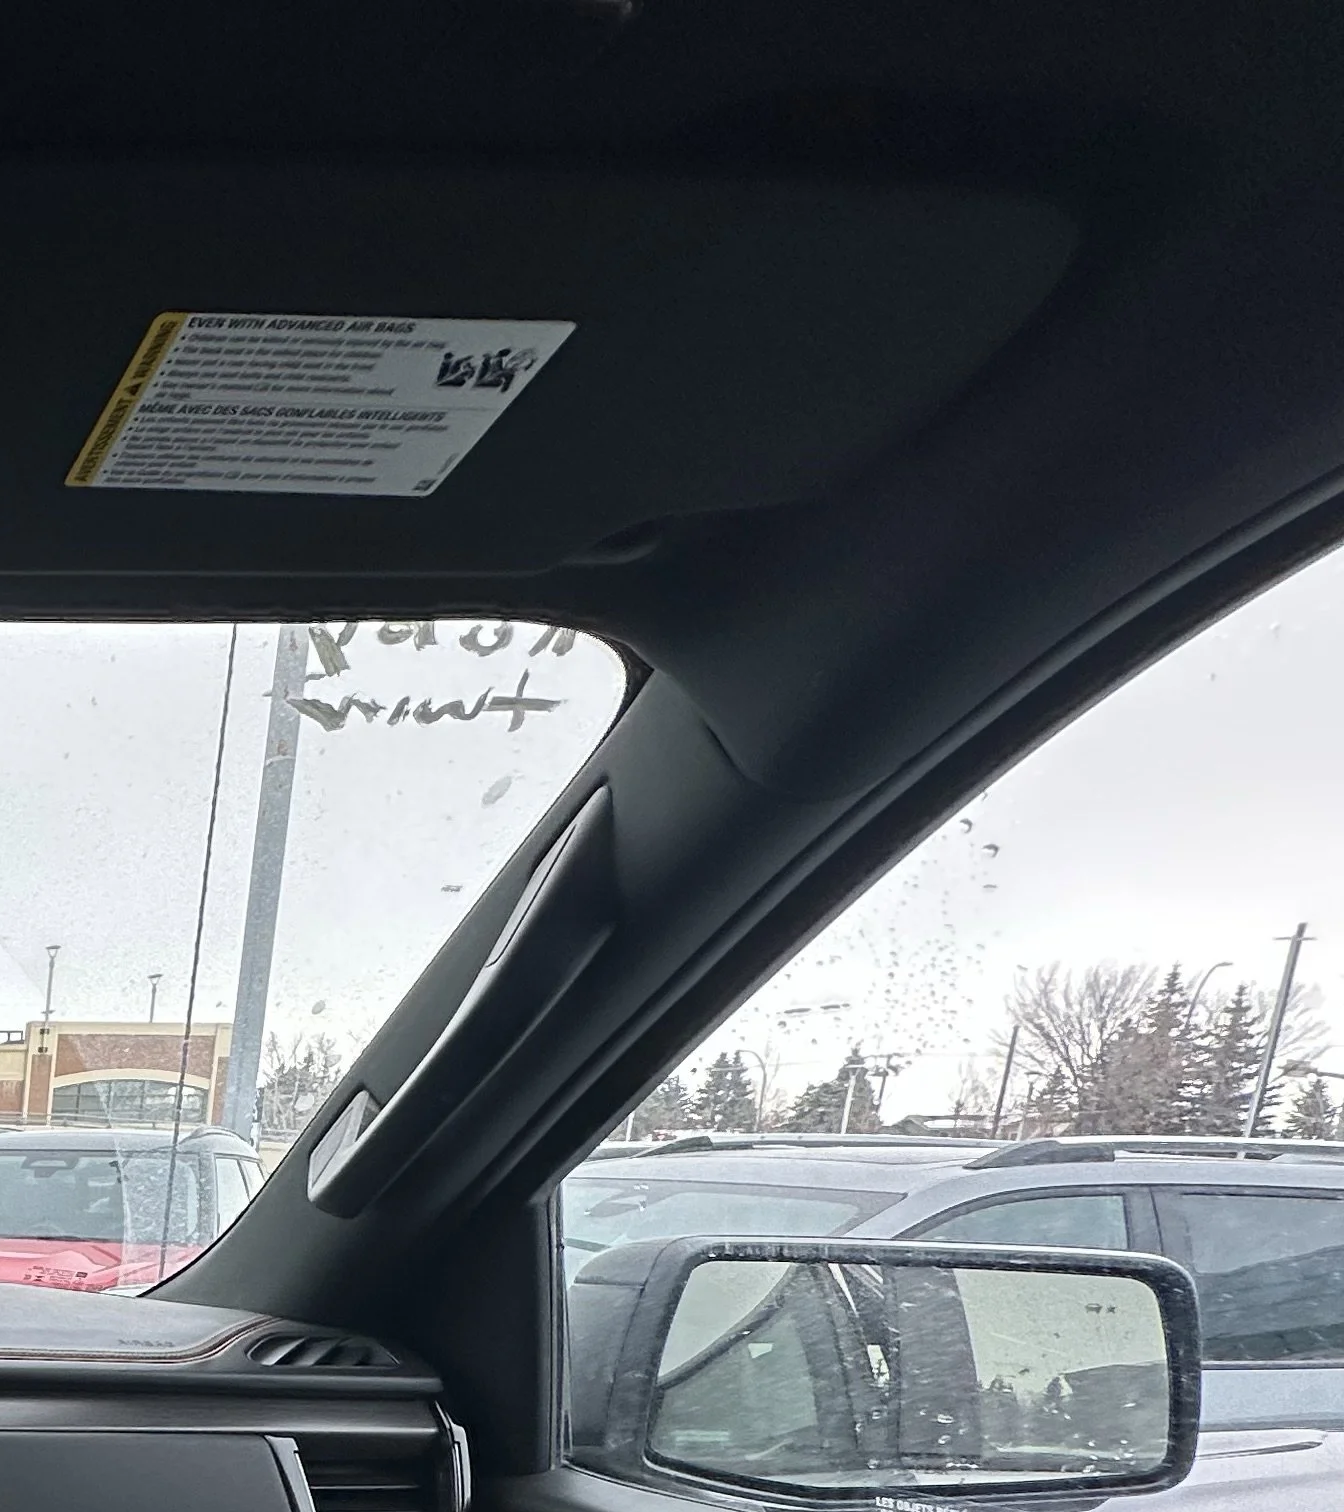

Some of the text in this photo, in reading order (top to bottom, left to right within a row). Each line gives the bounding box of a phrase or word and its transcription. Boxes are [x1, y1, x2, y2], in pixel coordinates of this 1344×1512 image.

[188, 316, 417, 333] EVEN WITH ADVANCED AIR BAGS
[177, 403, 213, 415] AVEC
[213, 404, 240, 415] DES
[240, 406, 276, 417] SACS
[276, 407, 355, 419] GONFLABLES
[356, 409, 447, 422] INTELLIGENTS
[875, 1496, 894, 1508] LES
